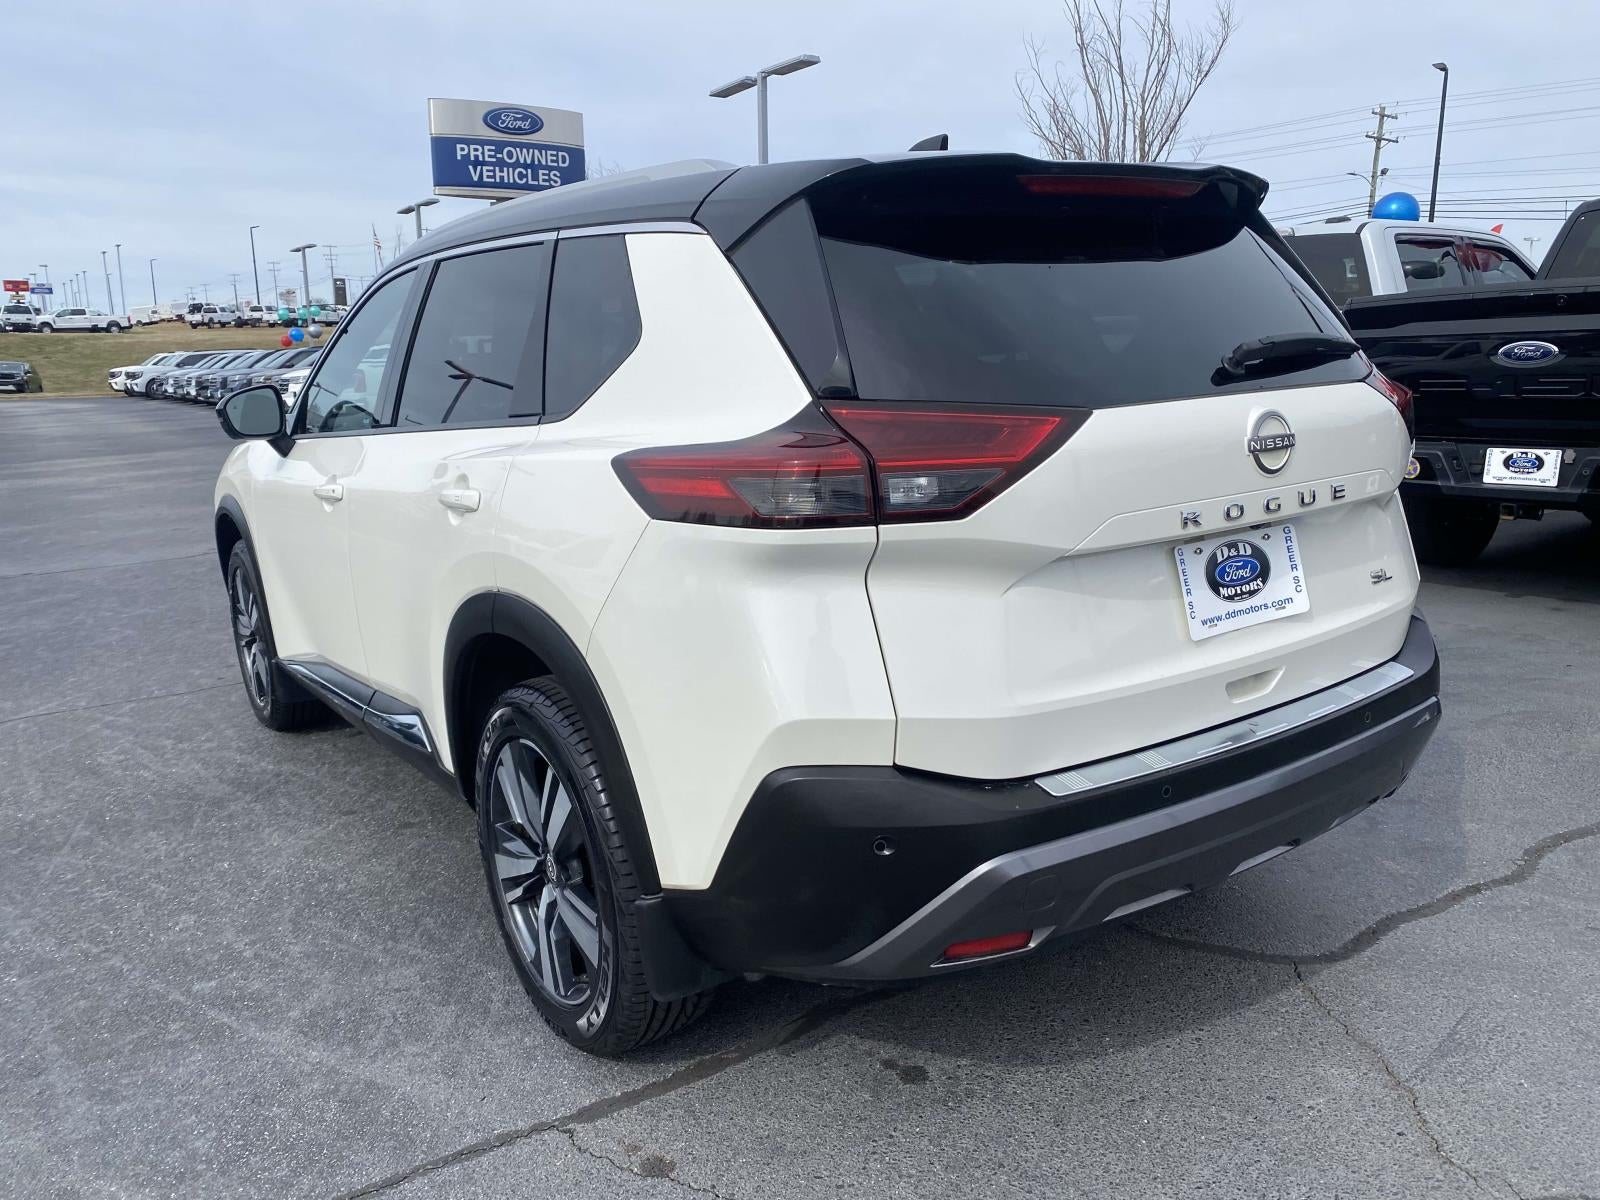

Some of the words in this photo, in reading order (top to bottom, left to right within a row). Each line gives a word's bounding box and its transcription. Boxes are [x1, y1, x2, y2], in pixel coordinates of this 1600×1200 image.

[498, 113, 531, 130] Ford
[456, 144, 570, 168] PRE-OWNED
[468, 165, 561, 187] VEHICLES
[1250, 435, 1296, 451] NISSAN
[1180, 484, 1346, 529] ROGUE
[1215, 542, 1252, 563] D&D
[1282, 525, 1299, 572] GREER
[1177, 547, 1193, 598] GREER
[1224, 561, 1252, 581] Ford
[1369, 568, 1393, 585] SL
[1218, 578, 1264, 599] MOTORS
[1201, 596, 1294, 627] www.ddmotors.com
